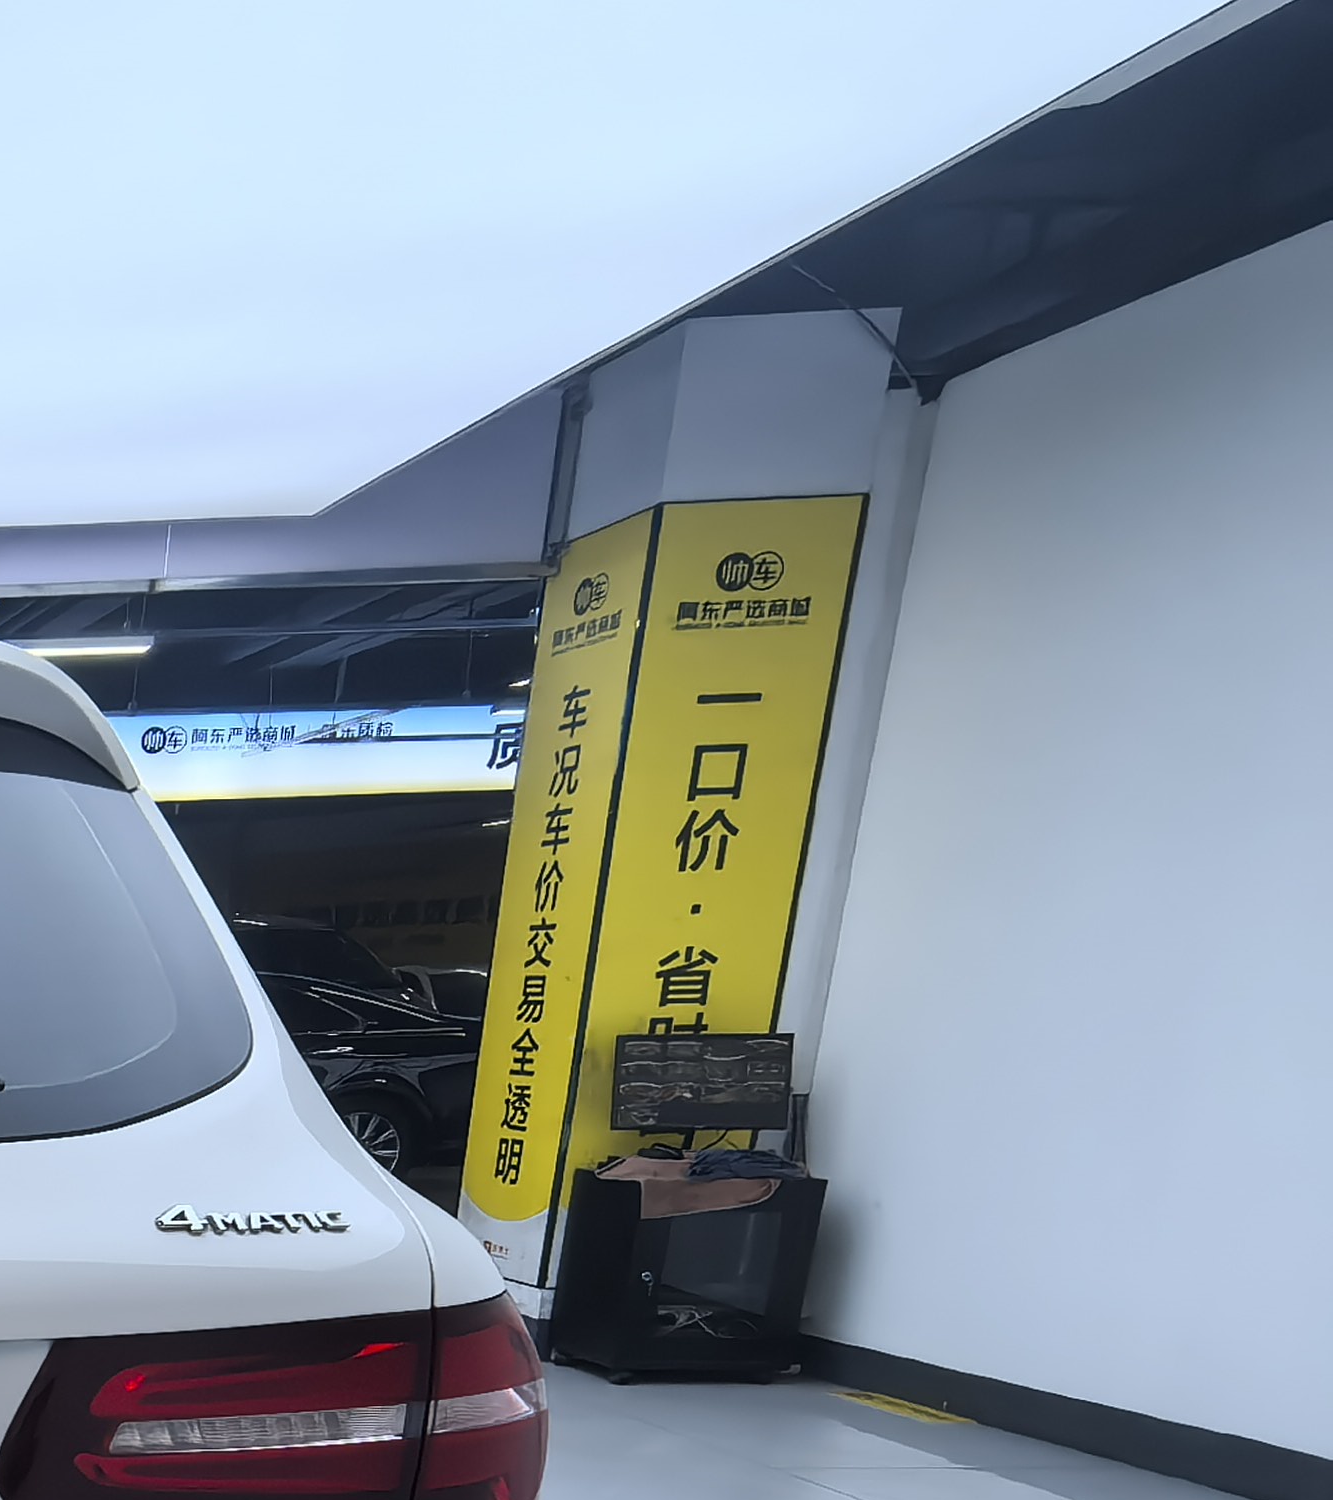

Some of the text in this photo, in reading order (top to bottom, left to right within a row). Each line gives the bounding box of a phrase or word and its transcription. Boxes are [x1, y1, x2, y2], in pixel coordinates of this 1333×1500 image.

[493, 684, 592, 1186] 车况车价交易全透明
[647, 692, 763, 1034] 一口价·省
[155, 1203, 352, 1236] 4MATIC
